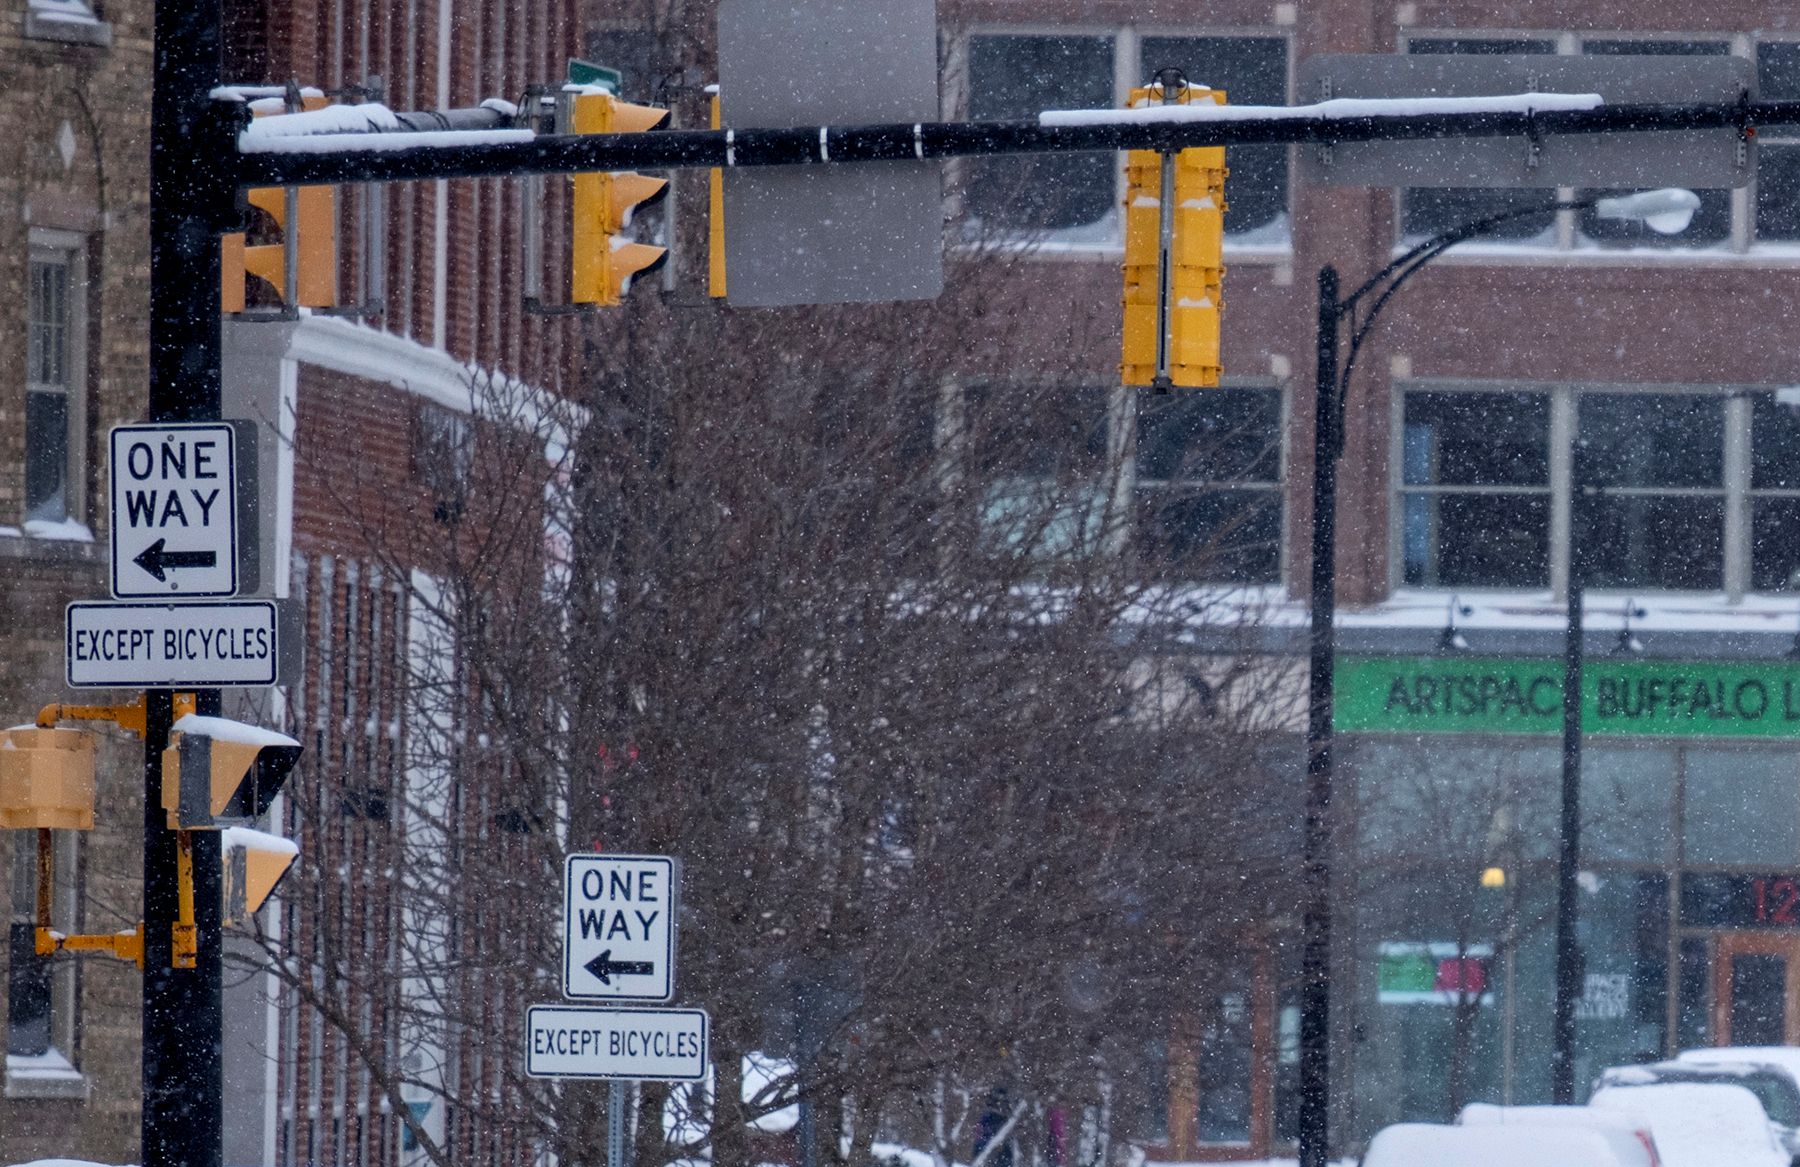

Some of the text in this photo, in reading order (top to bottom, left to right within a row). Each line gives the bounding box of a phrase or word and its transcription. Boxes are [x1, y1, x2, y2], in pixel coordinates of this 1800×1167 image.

[127, 441, 218, 480] ONE
[125, 489, 220, 528] WAY
[75, 627, 269, 661] EXCEPT BICYCLES
[1385, 675, 1563, 716] ARTSPAC
[1597, 677, 1769, 721] BUFFALO
[581, 868, 658, 902] ONE
[579, 908, 660, 941] WAY
[534, 1028, 699, 1058] EXCEPT BICYCLES
